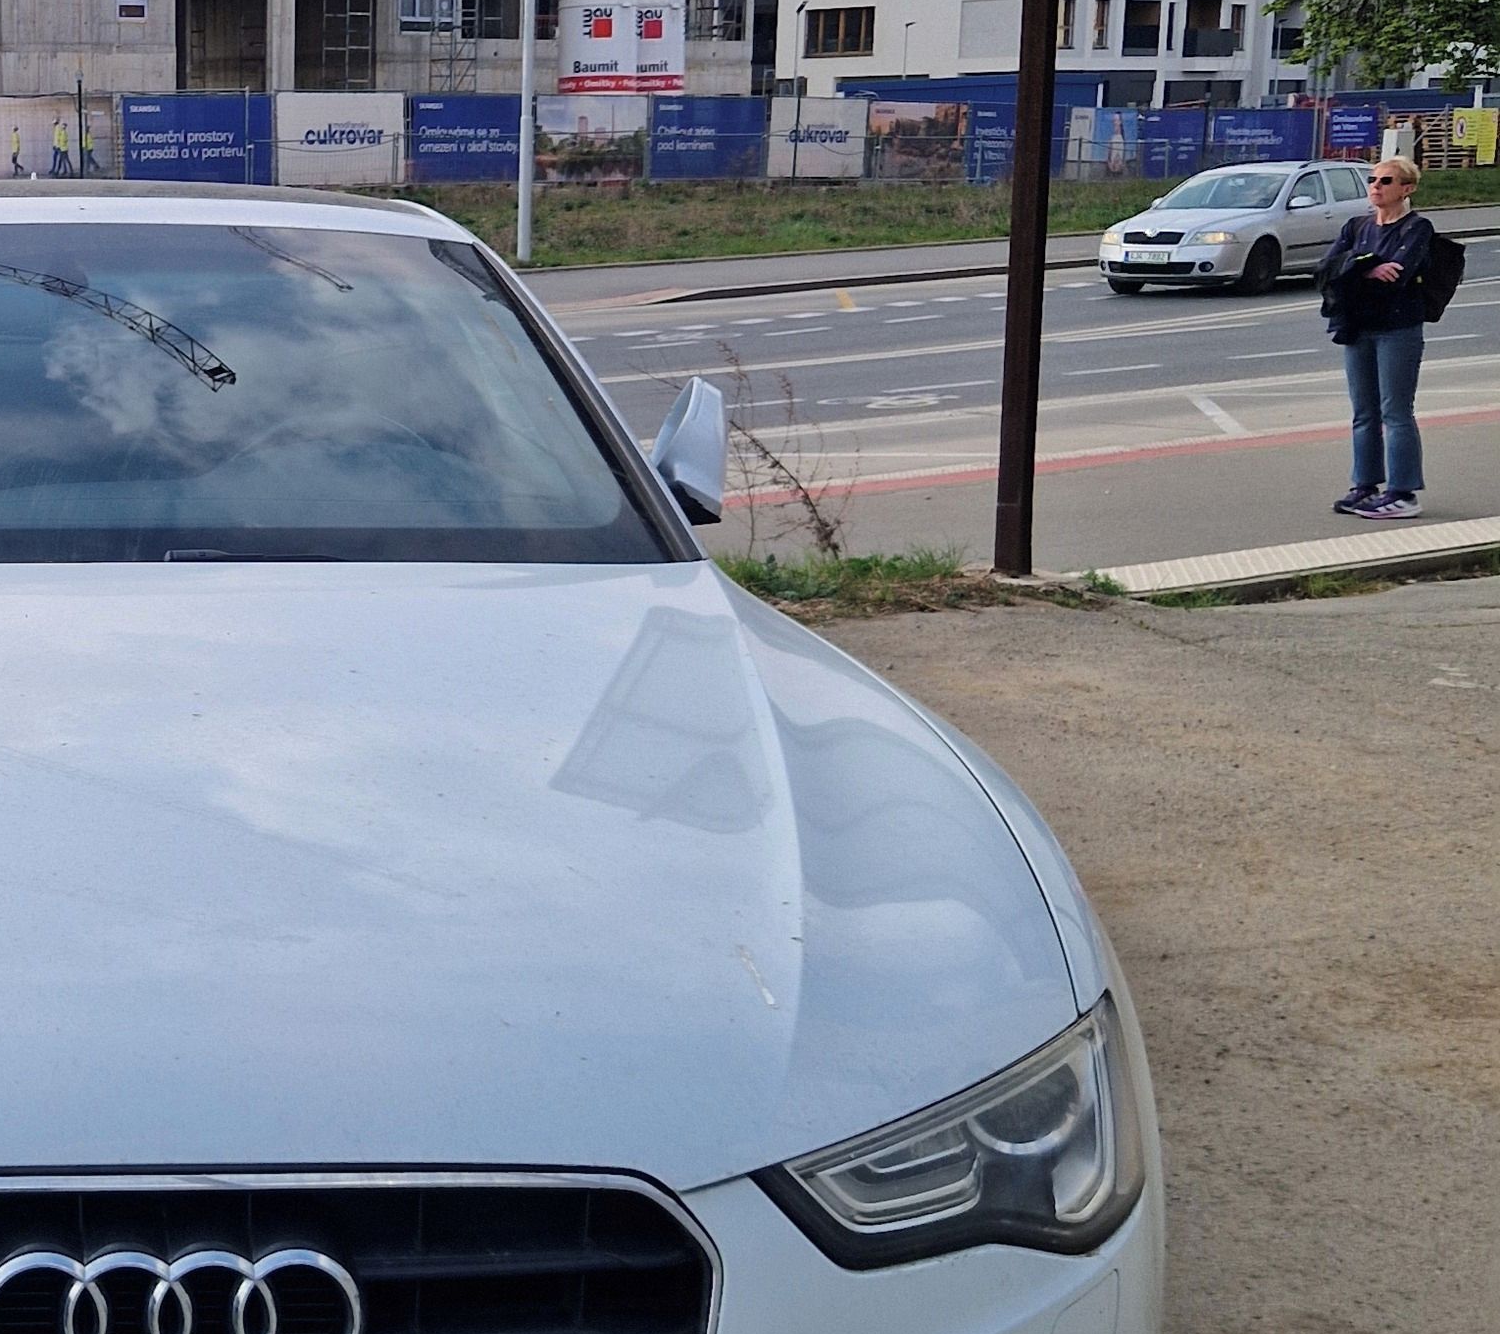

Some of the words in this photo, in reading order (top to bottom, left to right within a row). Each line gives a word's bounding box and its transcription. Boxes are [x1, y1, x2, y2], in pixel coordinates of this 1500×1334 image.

[573, 59, 619, 73] Baumit
[129, 105, 161, 113] SKANSKA
[130, 130, 184, 144] Komerční
[187, 130, 235, 145] prostory
[131, 149, 138, 159] v
[141, 147, 179, 162] pasáži
[181, 149, 190, 159] a
[191, 148, 199, 159] v
